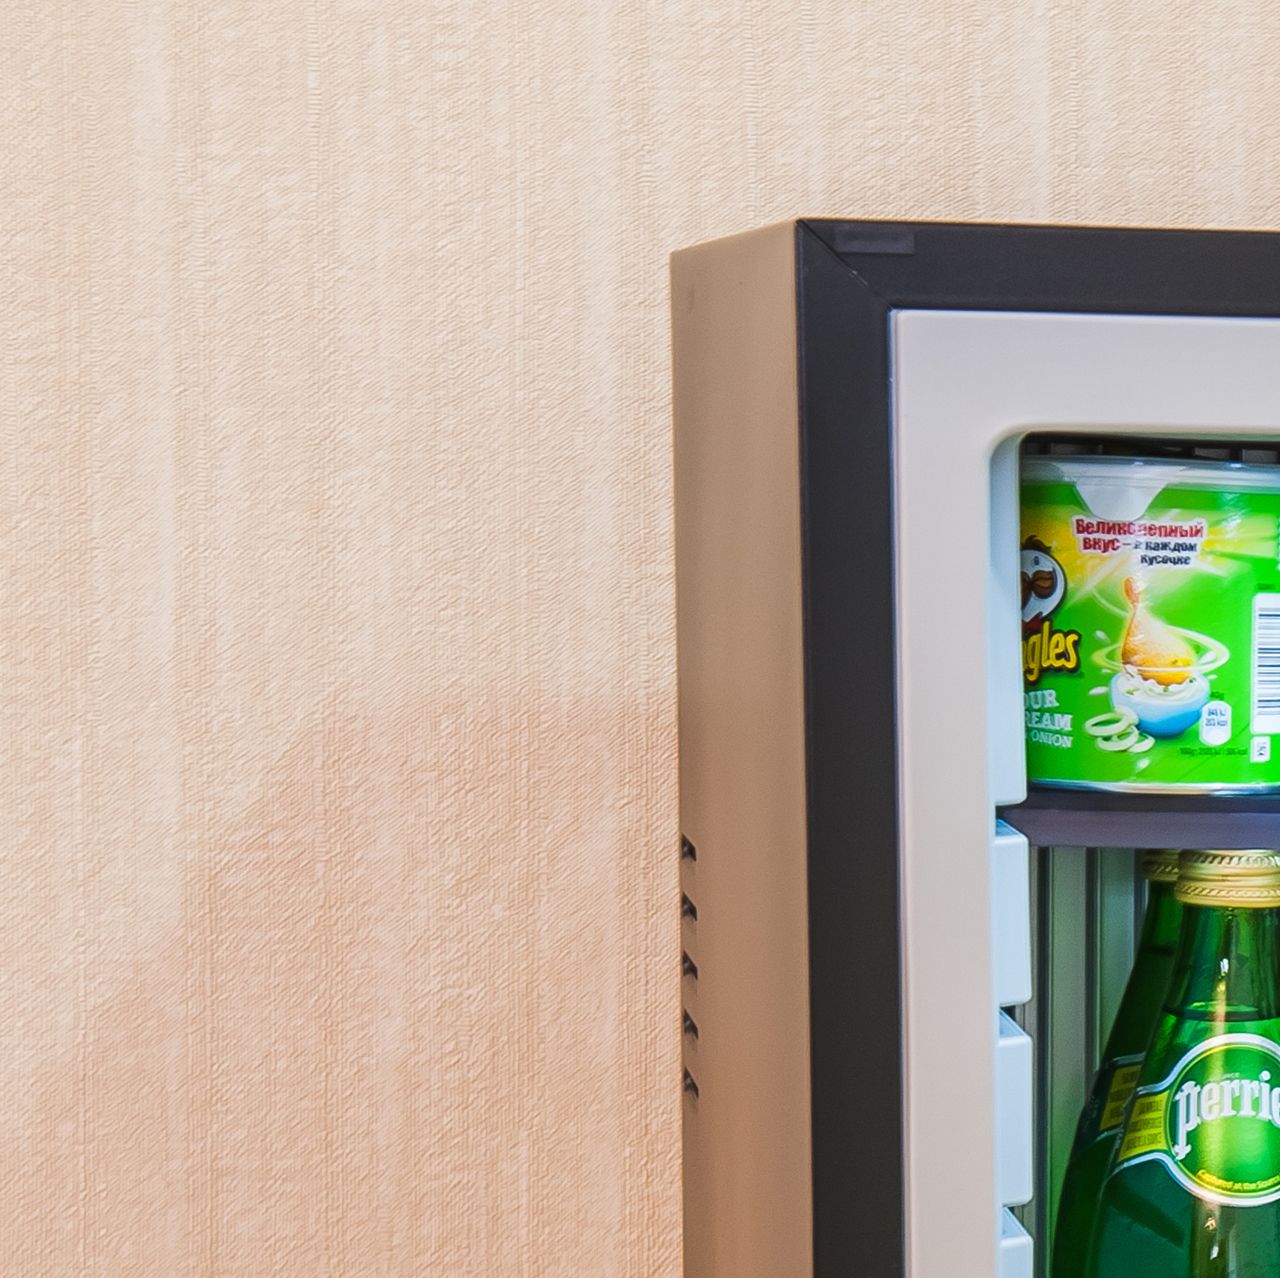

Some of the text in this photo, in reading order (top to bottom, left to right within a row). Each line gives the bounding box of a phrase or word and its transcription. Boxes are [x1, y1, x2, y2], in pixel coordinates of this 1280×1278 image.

[1082, 537, 1120, 553] вкус
[1145, 541, 1197, 553] каждом
[1140, 555, 1191, 567] кусочке
[1022, 624, 1078, 682] gles
[1024, 690, 1059, 708] OUR
[1025, 713, 1072, 731] REAM
